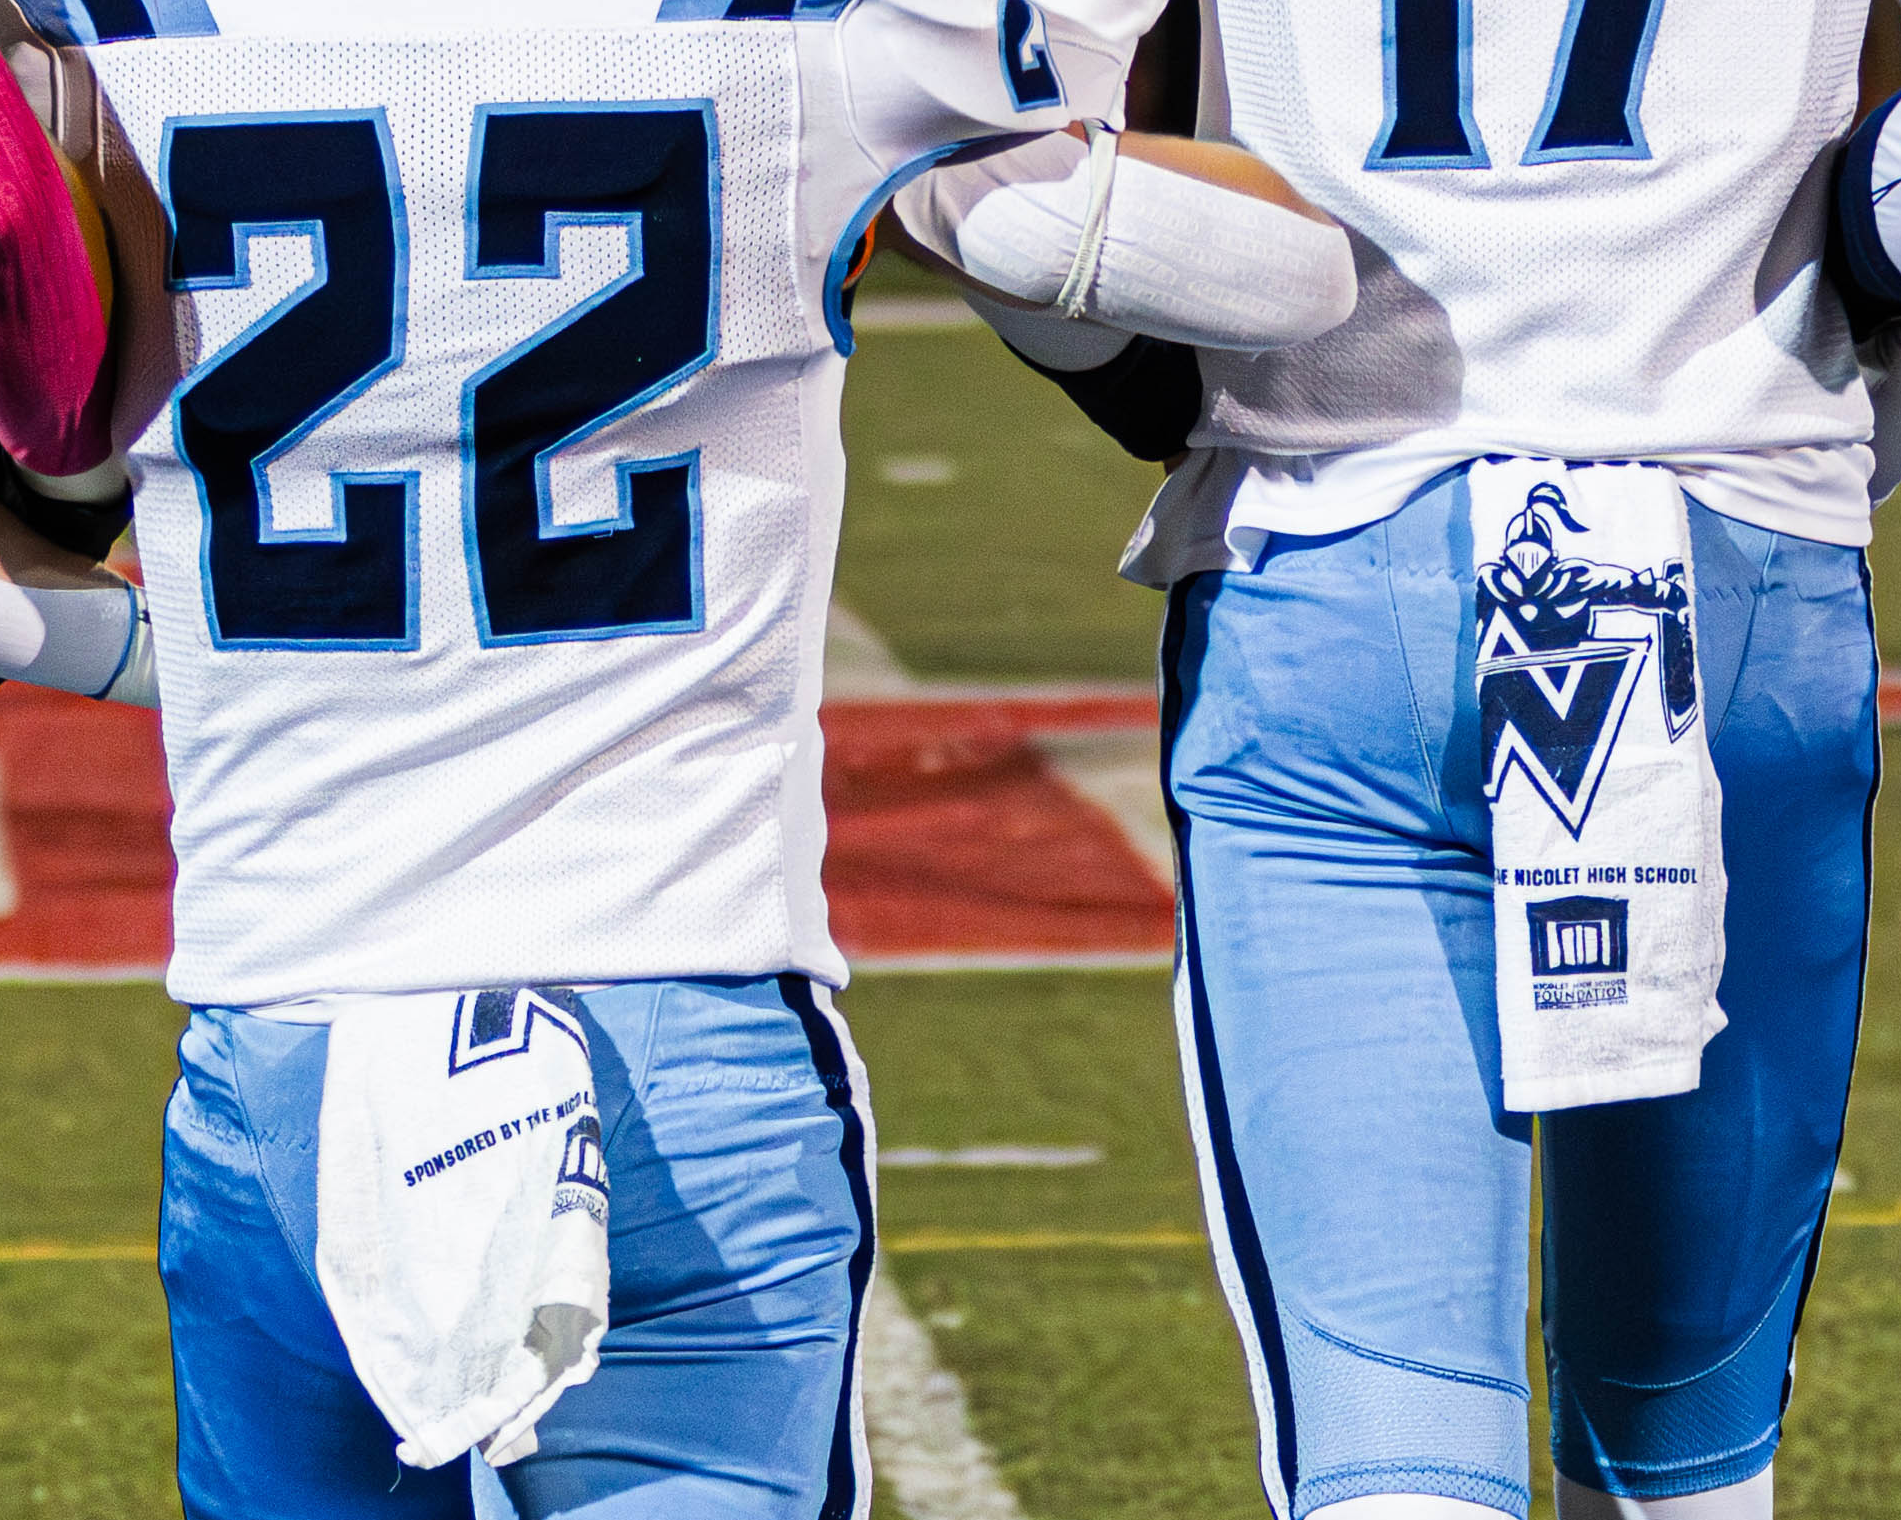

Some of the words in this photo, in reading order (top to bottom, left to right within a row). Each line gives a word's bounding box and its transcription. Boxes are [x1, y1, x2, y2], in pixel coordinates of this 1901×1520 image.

[157, 98, 722, 651] 22
[1515, 867, 1580, 886] NICOLET
[1588, 866, 1626, 884] HIGH
[1634, 866, 1698, 885] SCHOOL
[1534, 986, 1627, 1002] FOUNDATION
[403, 1129, 497, 1187] SPONSORED
[499, 1119, 522, 1141] BY
